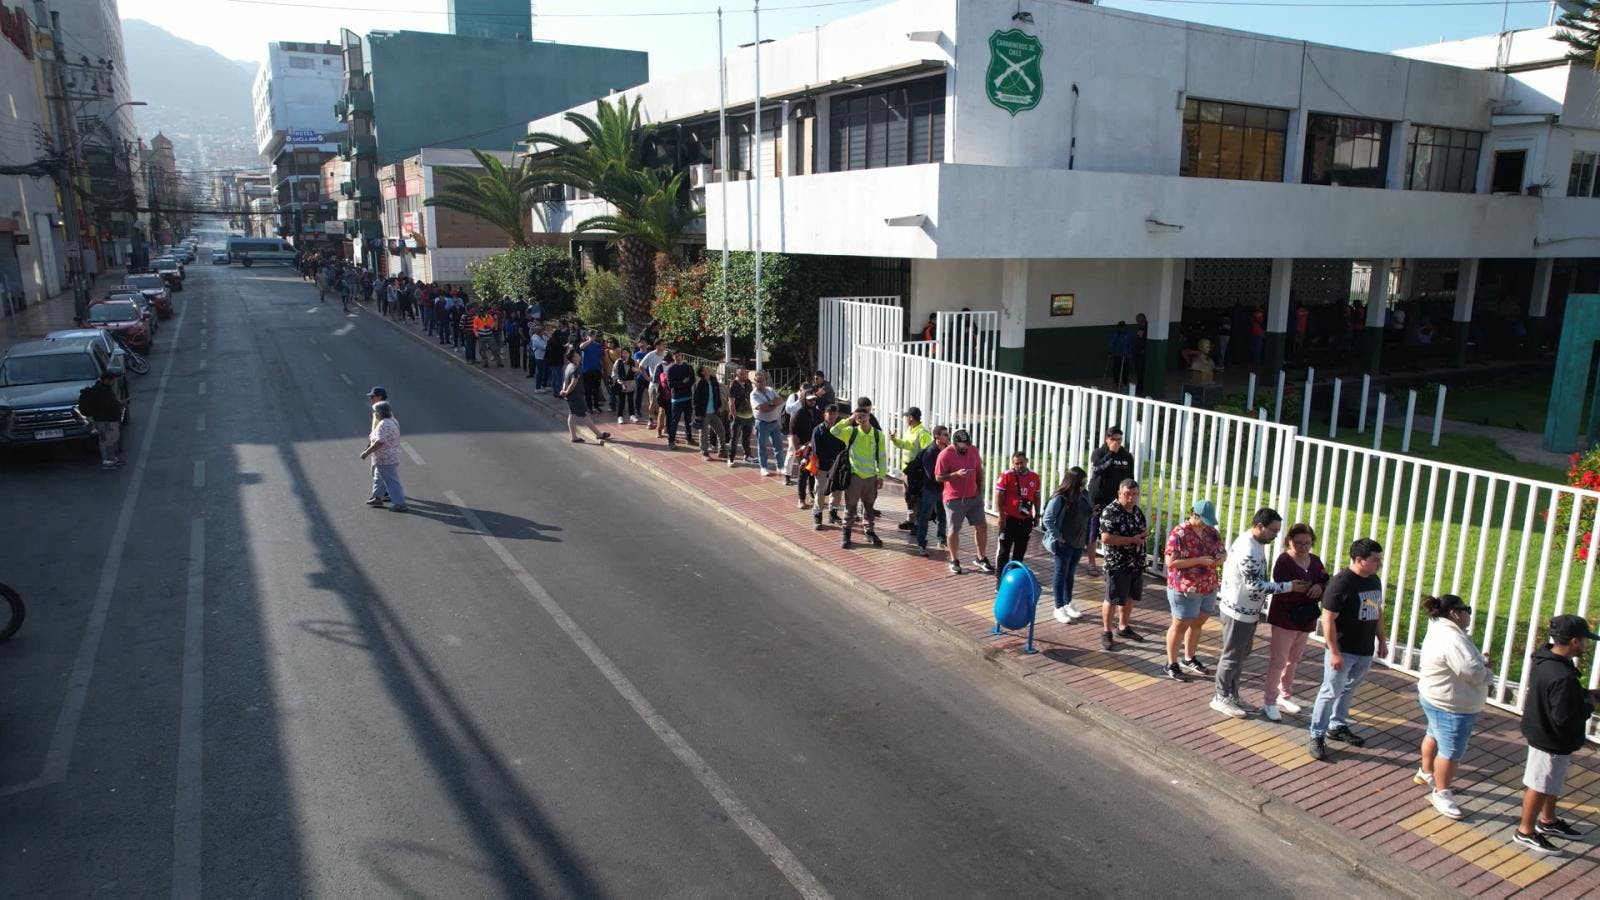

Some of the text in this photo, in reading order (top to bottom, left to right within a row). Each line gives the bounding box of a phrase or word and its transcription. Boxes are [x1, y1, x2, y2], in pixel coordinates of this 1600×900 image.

[996, 39, 1027, 50] CARABINEROS
[1008, 48, 1022, 57] CHILE
[1020, 488, 1028, 496] 10
